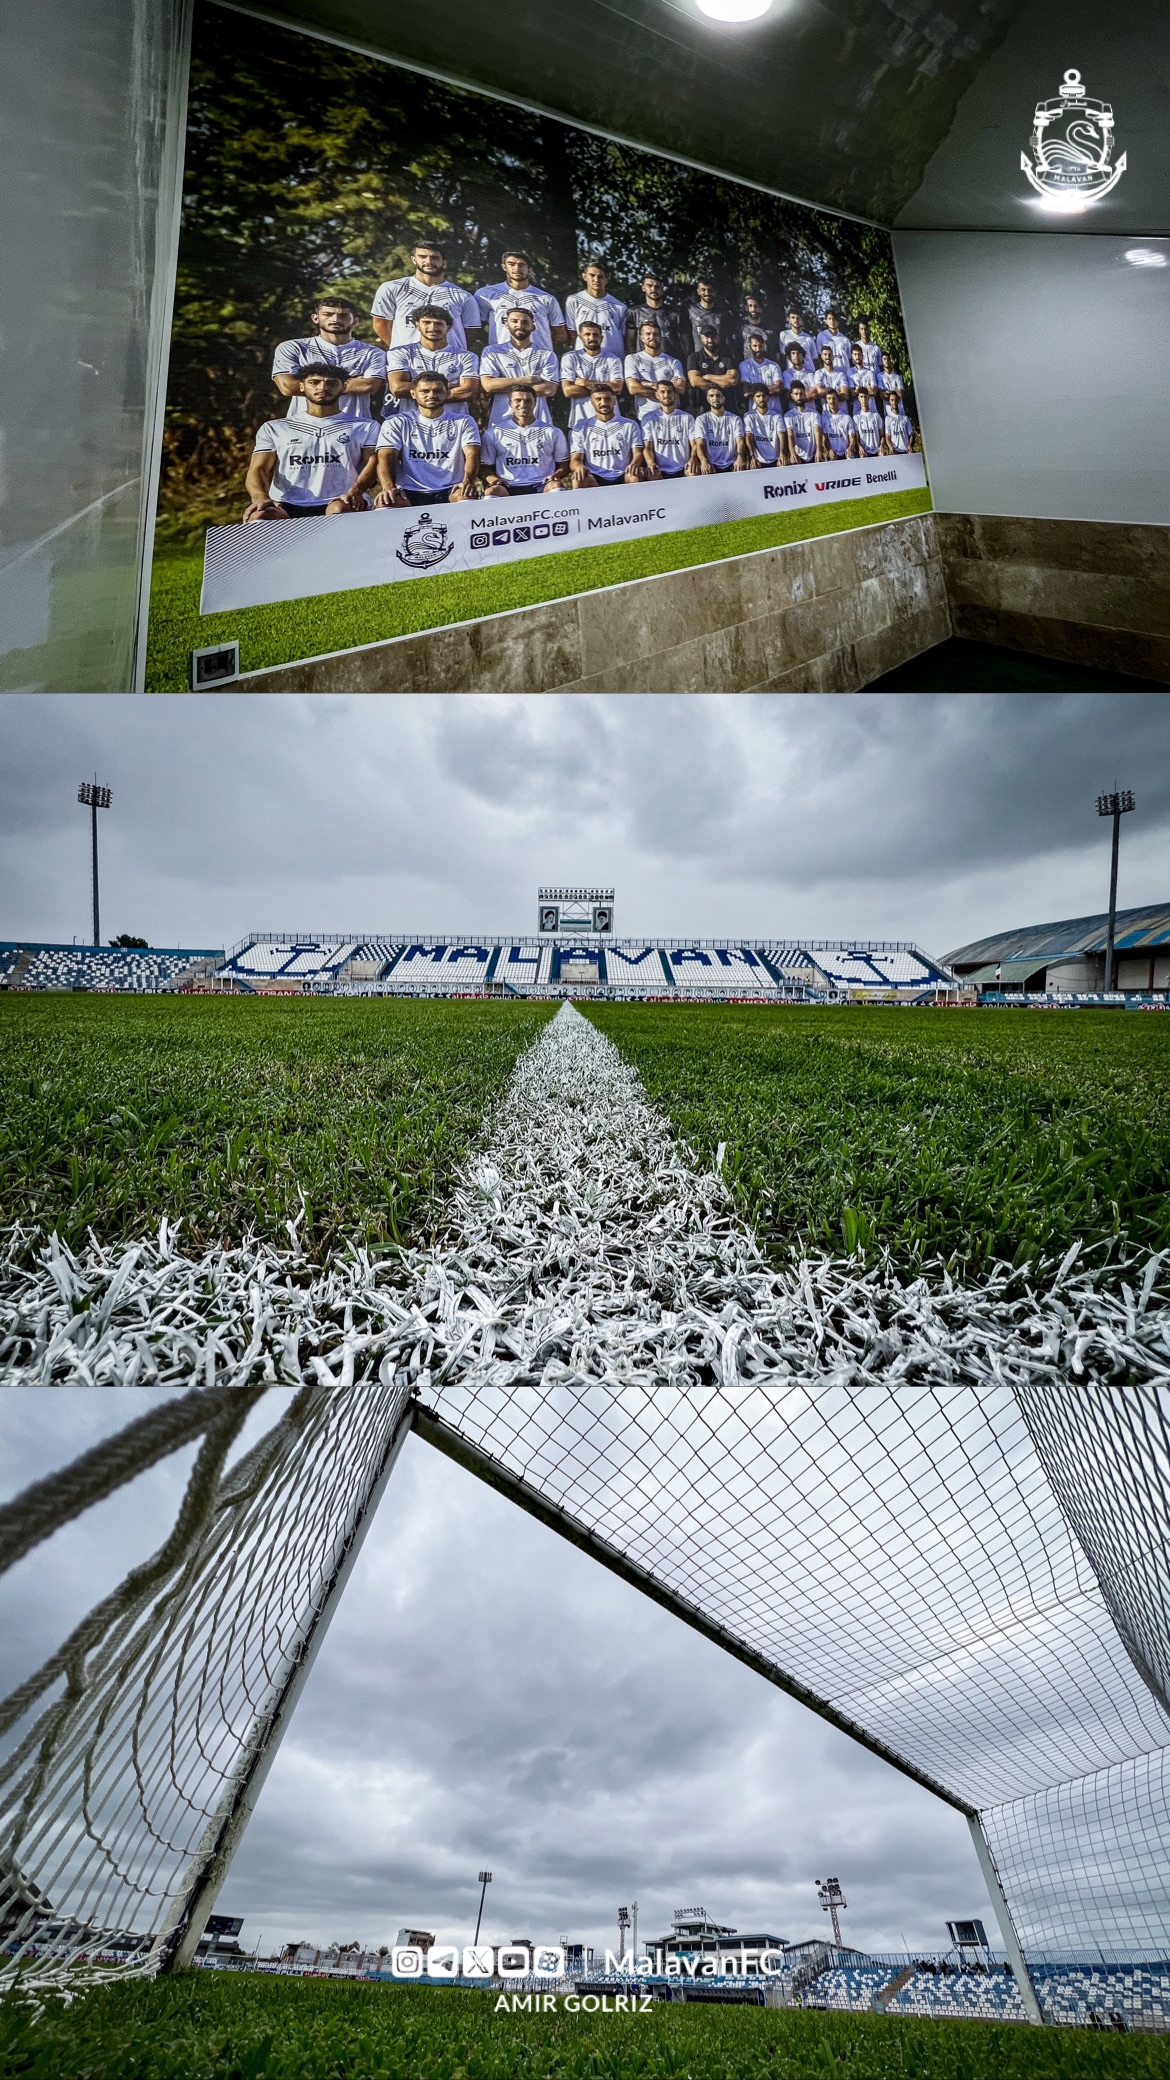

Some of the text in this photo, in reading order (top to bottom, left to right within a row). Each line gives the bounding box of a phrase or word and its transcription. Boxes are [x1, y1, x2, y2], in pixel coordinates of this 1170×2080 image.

[657, 437, 680, 446] Ronix
[290, 452, 342, 466] Ronix
[409, 449, 450, 460] Ronix
[593, 448, 622, 458] Ronix
[506, 456, 539, 466] Ronix
[866, 470, 897, 484] Benelli
[763, 480, 808, 499] Ronix
[471, 508, 580, 530] MalavanFC.com
[588, 508, 666, 530] MalavanFC
[402, 944, 760, 967] MALAVAN
